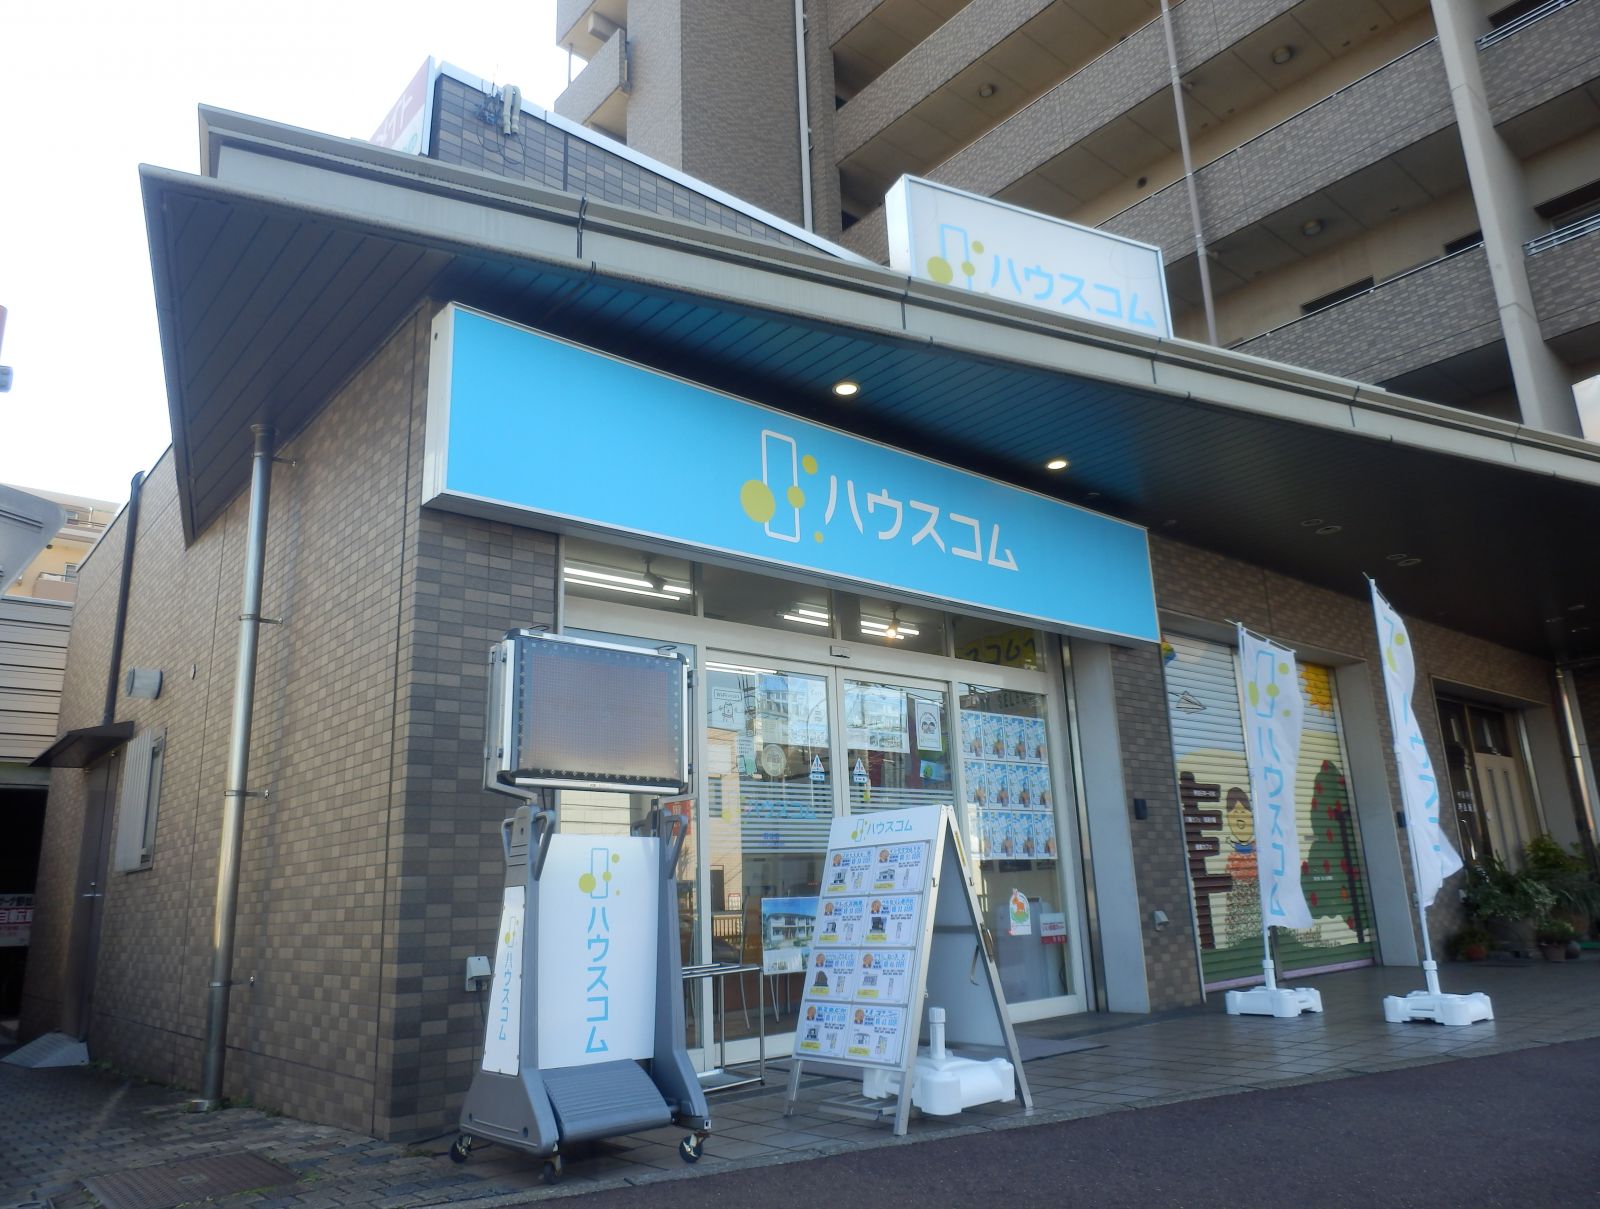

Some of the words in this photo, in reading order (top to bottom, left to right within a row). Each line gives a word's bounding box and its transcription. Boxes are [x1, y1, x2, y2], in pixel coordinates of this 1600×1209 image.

[991, 254, 1157, 329] ハウスコム
[824, 474, 1019, 572] ハウスコム
[866, 819, 913, 835] ハウスコム
[1257, 726, 1287, 917] ハウスコム
[498, 951, 513, 1041] ハウスコム
[585, 906, 610, 1054] ハウスコム
